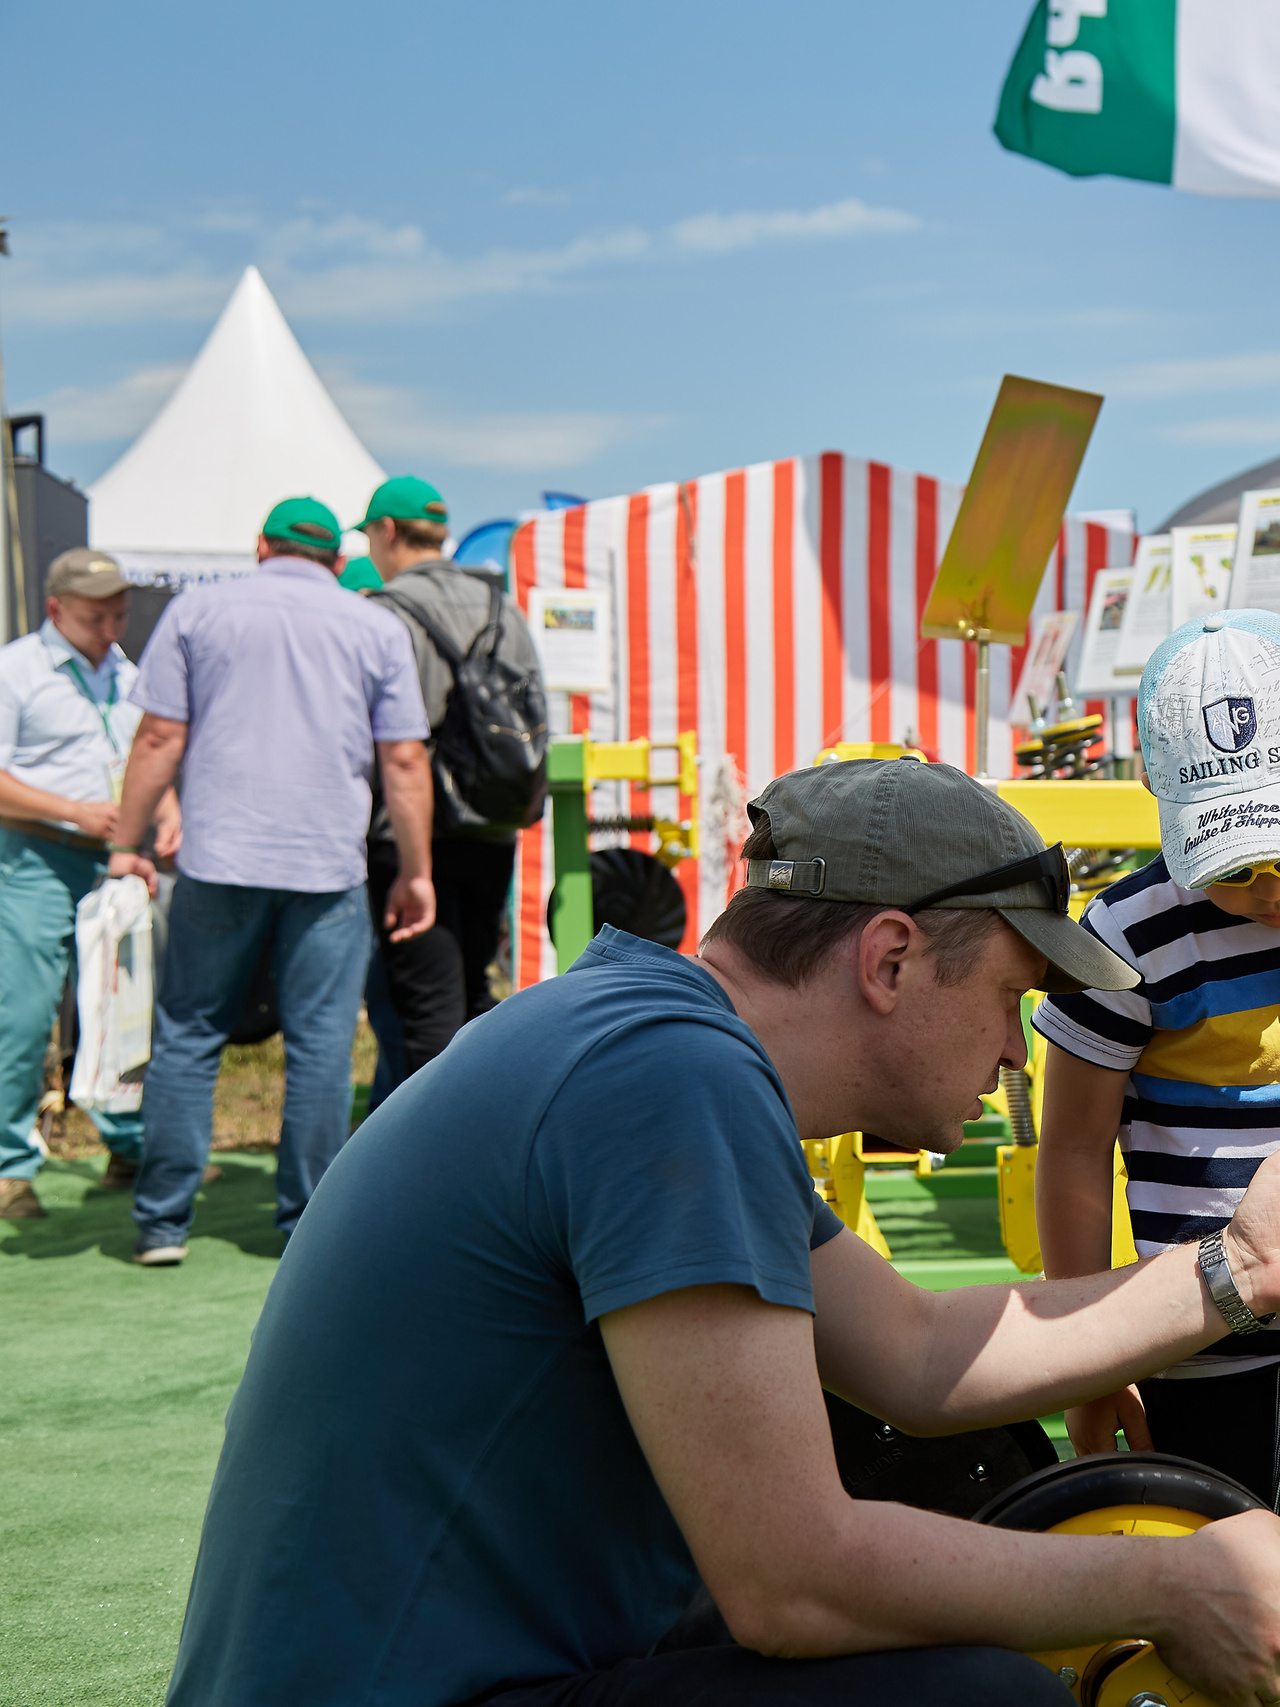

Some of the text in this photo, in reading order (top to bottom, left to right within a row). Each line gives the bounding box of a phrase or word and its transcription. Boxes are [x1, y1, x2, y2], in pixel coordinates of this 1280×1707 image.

[1179, 752, 1259, 784] SAILING
[1197, 800, 1280, 829] Whiteshore
[1184, 827, 1220, 855] Cruise
